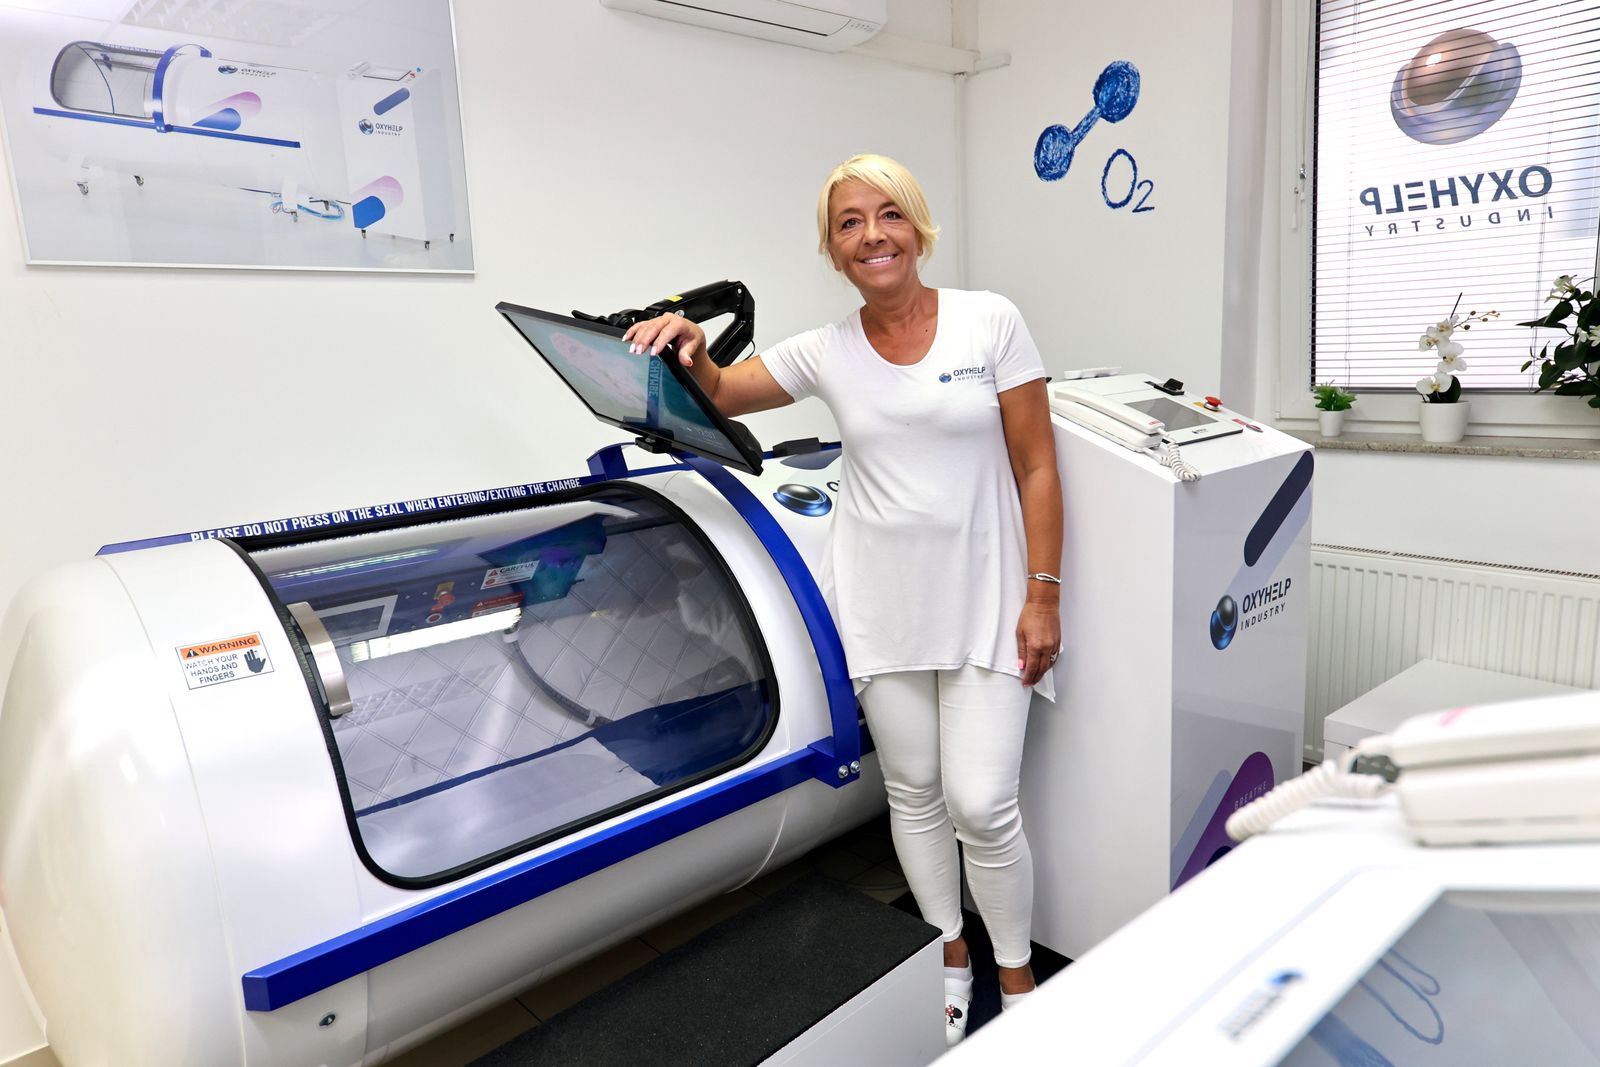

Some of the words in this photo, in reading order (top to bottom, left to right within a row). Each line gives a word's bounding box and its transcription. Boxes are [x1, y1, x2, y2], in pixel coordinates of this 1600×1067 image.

[375, 122, 404, 132] OXYHELP
[953, 366, 986, 377] OXYHELP
[244, 524, 262, 537] DO
[264, 519, 289, 535] NOT
[292, 513, 331, 530] PRESS
[333, 510, 349, 524] ON
[351, 507, 373, 521] THE
[375, 503, 403, 517] SEAL
[403, 498, 436, 513] WHEN
[437, 484, 527, 509] ENTERING/EXITING
[527, 482, 546, 495] THE
[546, 478, 582, 492] CHAMBE
[1242, 577, 1292, 614] OXYHELP
[1240, 602, 1286, 631] INDUSTRY
[199, 637, 257, 654] WARNING
[184, 658, 214, 670] WATCH
[215, 653, 239, 664] YOUR
[190, 665, 220, 677] HANDS
[221, 661, 238, 671] AND
[199, 670, 235, 684] FINGERS
